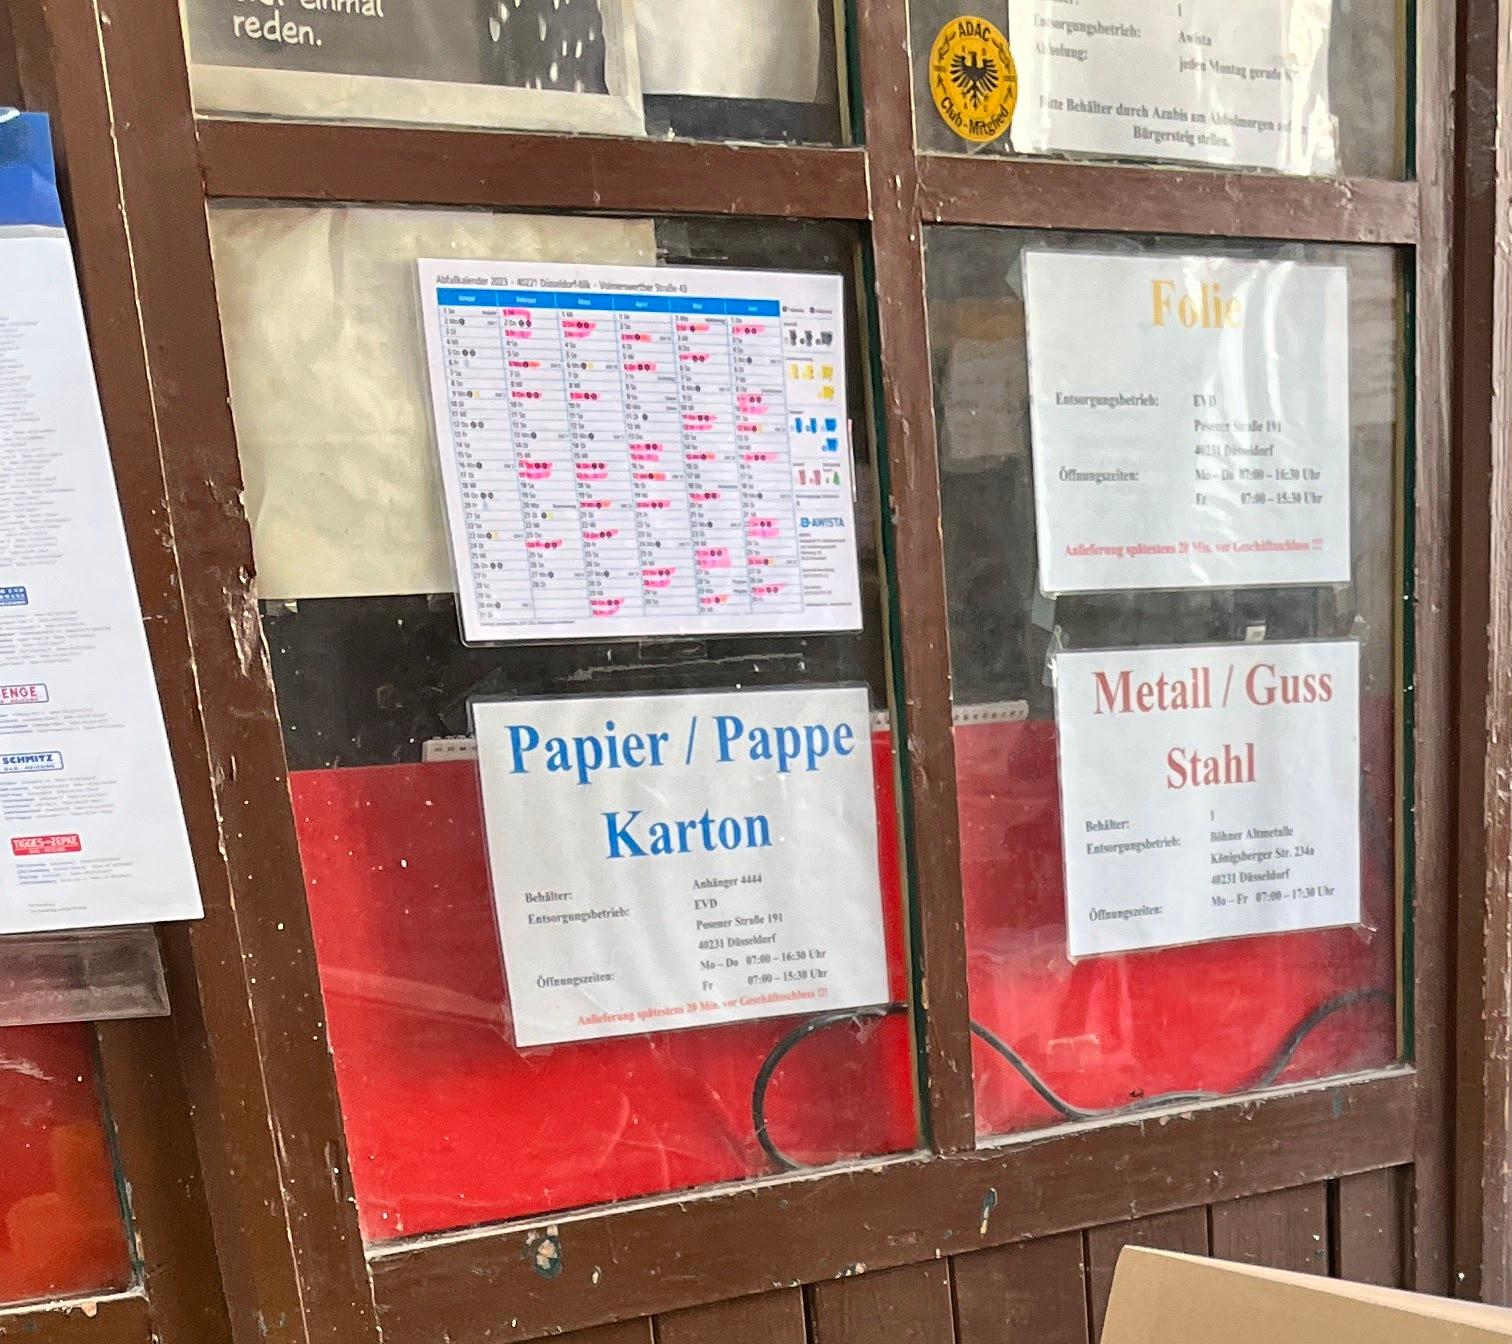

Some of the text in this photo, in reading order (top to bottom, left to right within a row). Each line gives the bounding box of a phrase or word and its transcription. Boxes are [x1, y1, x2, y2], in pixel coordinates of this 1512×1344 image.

[232, 9, 323, 47] reden.
[958, 20, 992, 42] ADAC
[1066, 98, 1113, 115] Behälter
[1115, 102, 1149, 118] durch
[1151, 106, 1189, 122] Azubis
[1133, 125, 1196, 147] Bürgersteig
[1150, 278, 1245, 330] Folie
[1054, 391, 1160, 410] Entsorgungsbetrieb:
[1057, 463, 1140, 485] Öffnungszeiten:
[1302, 468, 1321, 480] Uhr
[1303, 491, 1323, 504] Uhr
[1064, 543, 1124, 559] Anlieferung
[1091, 666, 1212, 715] Metall
[1245, 663, 1334, 706] Guss
[2, 754, 54, 765] SCHMITZ
[504, 720, 669, 786] Papier
[713, 714, 855, 773] Pappe
[1166, 742, 1257, 790] Stahl
[603, 807, 773, 860] Karton
[1084, 818, 1131, 833] Behälter:
[1085, 836, 1182, 856] Entsorgungsbetrieb:
[1246, 825, 1294, 840] Altmetalle
[1210, 851, 1273, 865] Königsberger
[1274, 847, 1293, 859] Str.
[1239, 868, 1291, 883] Düsseldorf
[524, 891, 573, 904] Behälter:
[693, 877, 739, 890] Anhänger
[527, 898, 718, 925] Entsorgungsbetrieb: EVD
[1088, 903, 1164, 922] Öffnungszeiten:
[1211, 895, 1227, 907] Mo
[1236, 893, 1249, 904] Fr
[1317, 884, 1336, 896] Uhr
[696, 912, 783, 930] Posener Straße 191
[698, 932, 777, 950] 40231 Düsseldorf
[536, 972, 615, 989] Öffnungszeiten:
[700, 959, 716, 970] Mo
[725, 958, 739, 968] Do
[746, 953, 771, 965] 07:00
[781, 950, 807, 962] 16:30
[808, 948, 827, 959] Uhr
[702, 980, 714, 991] Fr
[747, 973, 773, 985] 07:00
[783, 969, 808, 982] 15:30
[810, 968, 829, 980] Uhr
[577, 1011, 636, 1026] Anlieferung
[637, 1004, 685, 1022] spätestens
